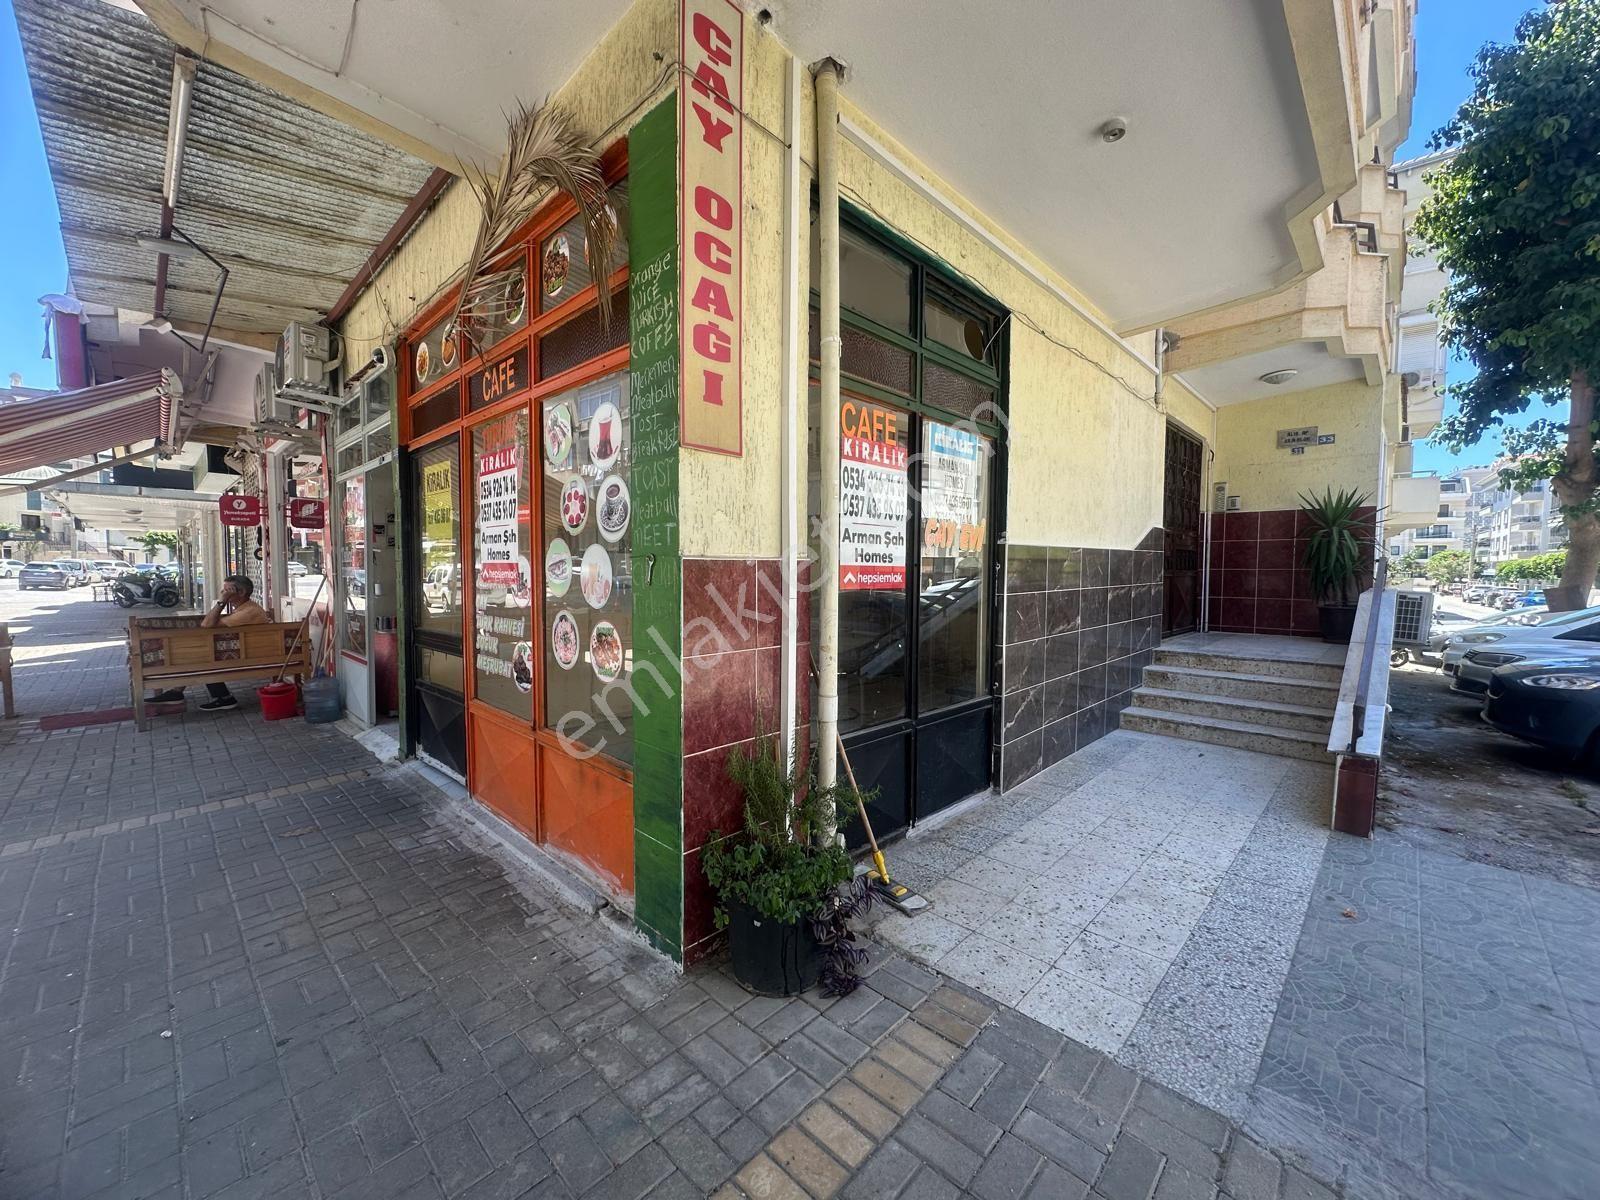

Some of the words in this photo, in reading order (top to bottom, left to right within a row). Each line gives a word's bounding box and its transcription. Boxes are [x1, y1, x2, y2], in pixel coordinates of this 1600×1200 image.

[691, 12, 734, 154] ÇAY
[691, 186, 734, 406] OCAĞI
[482, 357, 515, 401] CAFE
[841, 402, 897, 446] CAFE
[842, 466, 865, 491] 0534
[508, 499, 516, 520] 07
[842, 493, 865, 517] 0537
[481, 531, 502, 546] Arman
[503, 528, 517, 546] Şah
[842, 528, 882, 545] Arman
[884, 530, 904, 549] Şah
[487, 548, 510, 561] Homes
[855, 548, 893, 564] Homes
[857, 572, 903, 585] hepsiemlak
